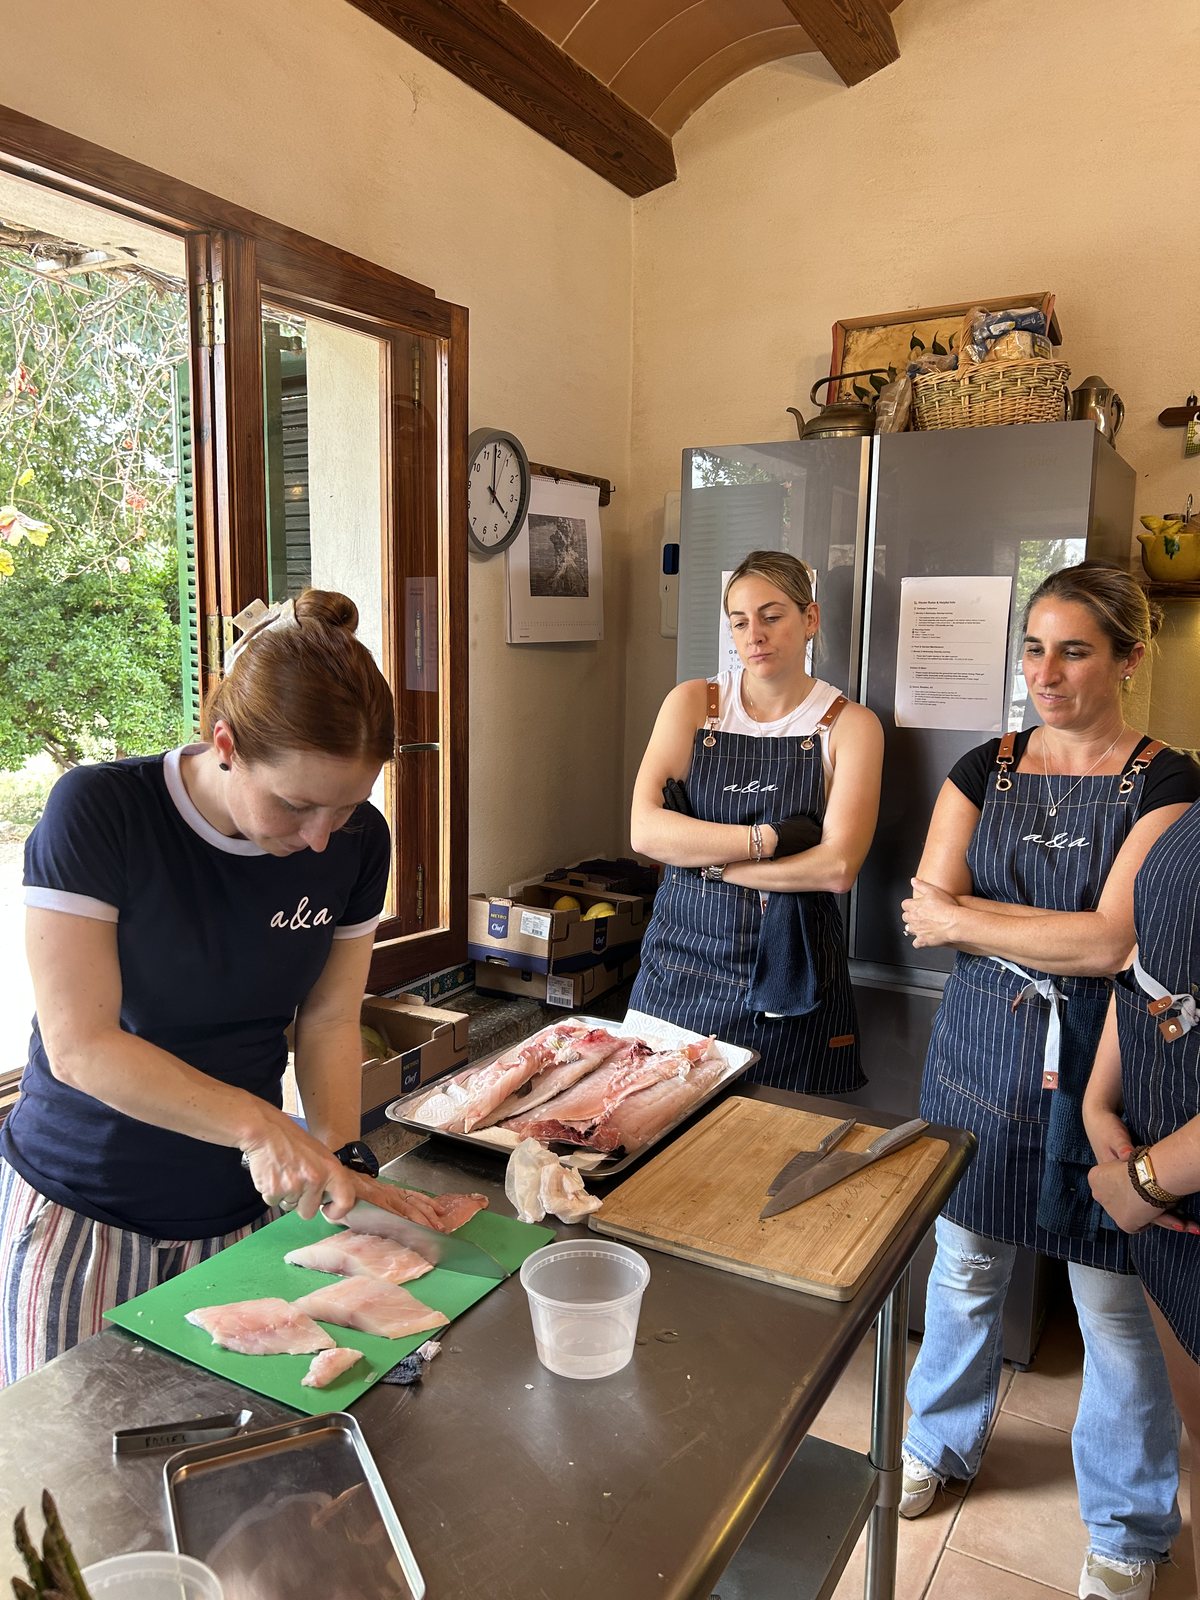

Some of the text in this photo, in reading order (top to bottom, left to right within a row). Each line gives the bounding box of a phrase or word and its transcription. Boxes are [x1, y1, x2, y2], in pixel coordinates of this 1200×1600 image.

[483, 450, 490, 461] 11
[473, 462, 481, 473] 10
[509, 475, 515, 484] 2
[509, 494, 514, 503] 3
[504, 511, 509, 519] 4
[472, 517, 477, 526] 7
[482, 525, 487, 535] 6
[493, 523, 498, 532] 5
[723, 780, 779, 794] a&a
[1022, 832, 1090, 849] a&a
[270, 895, 333, 930] a&a
[490, 912, 507, 920] METRO
[491, 922, 505, 933] Chef
